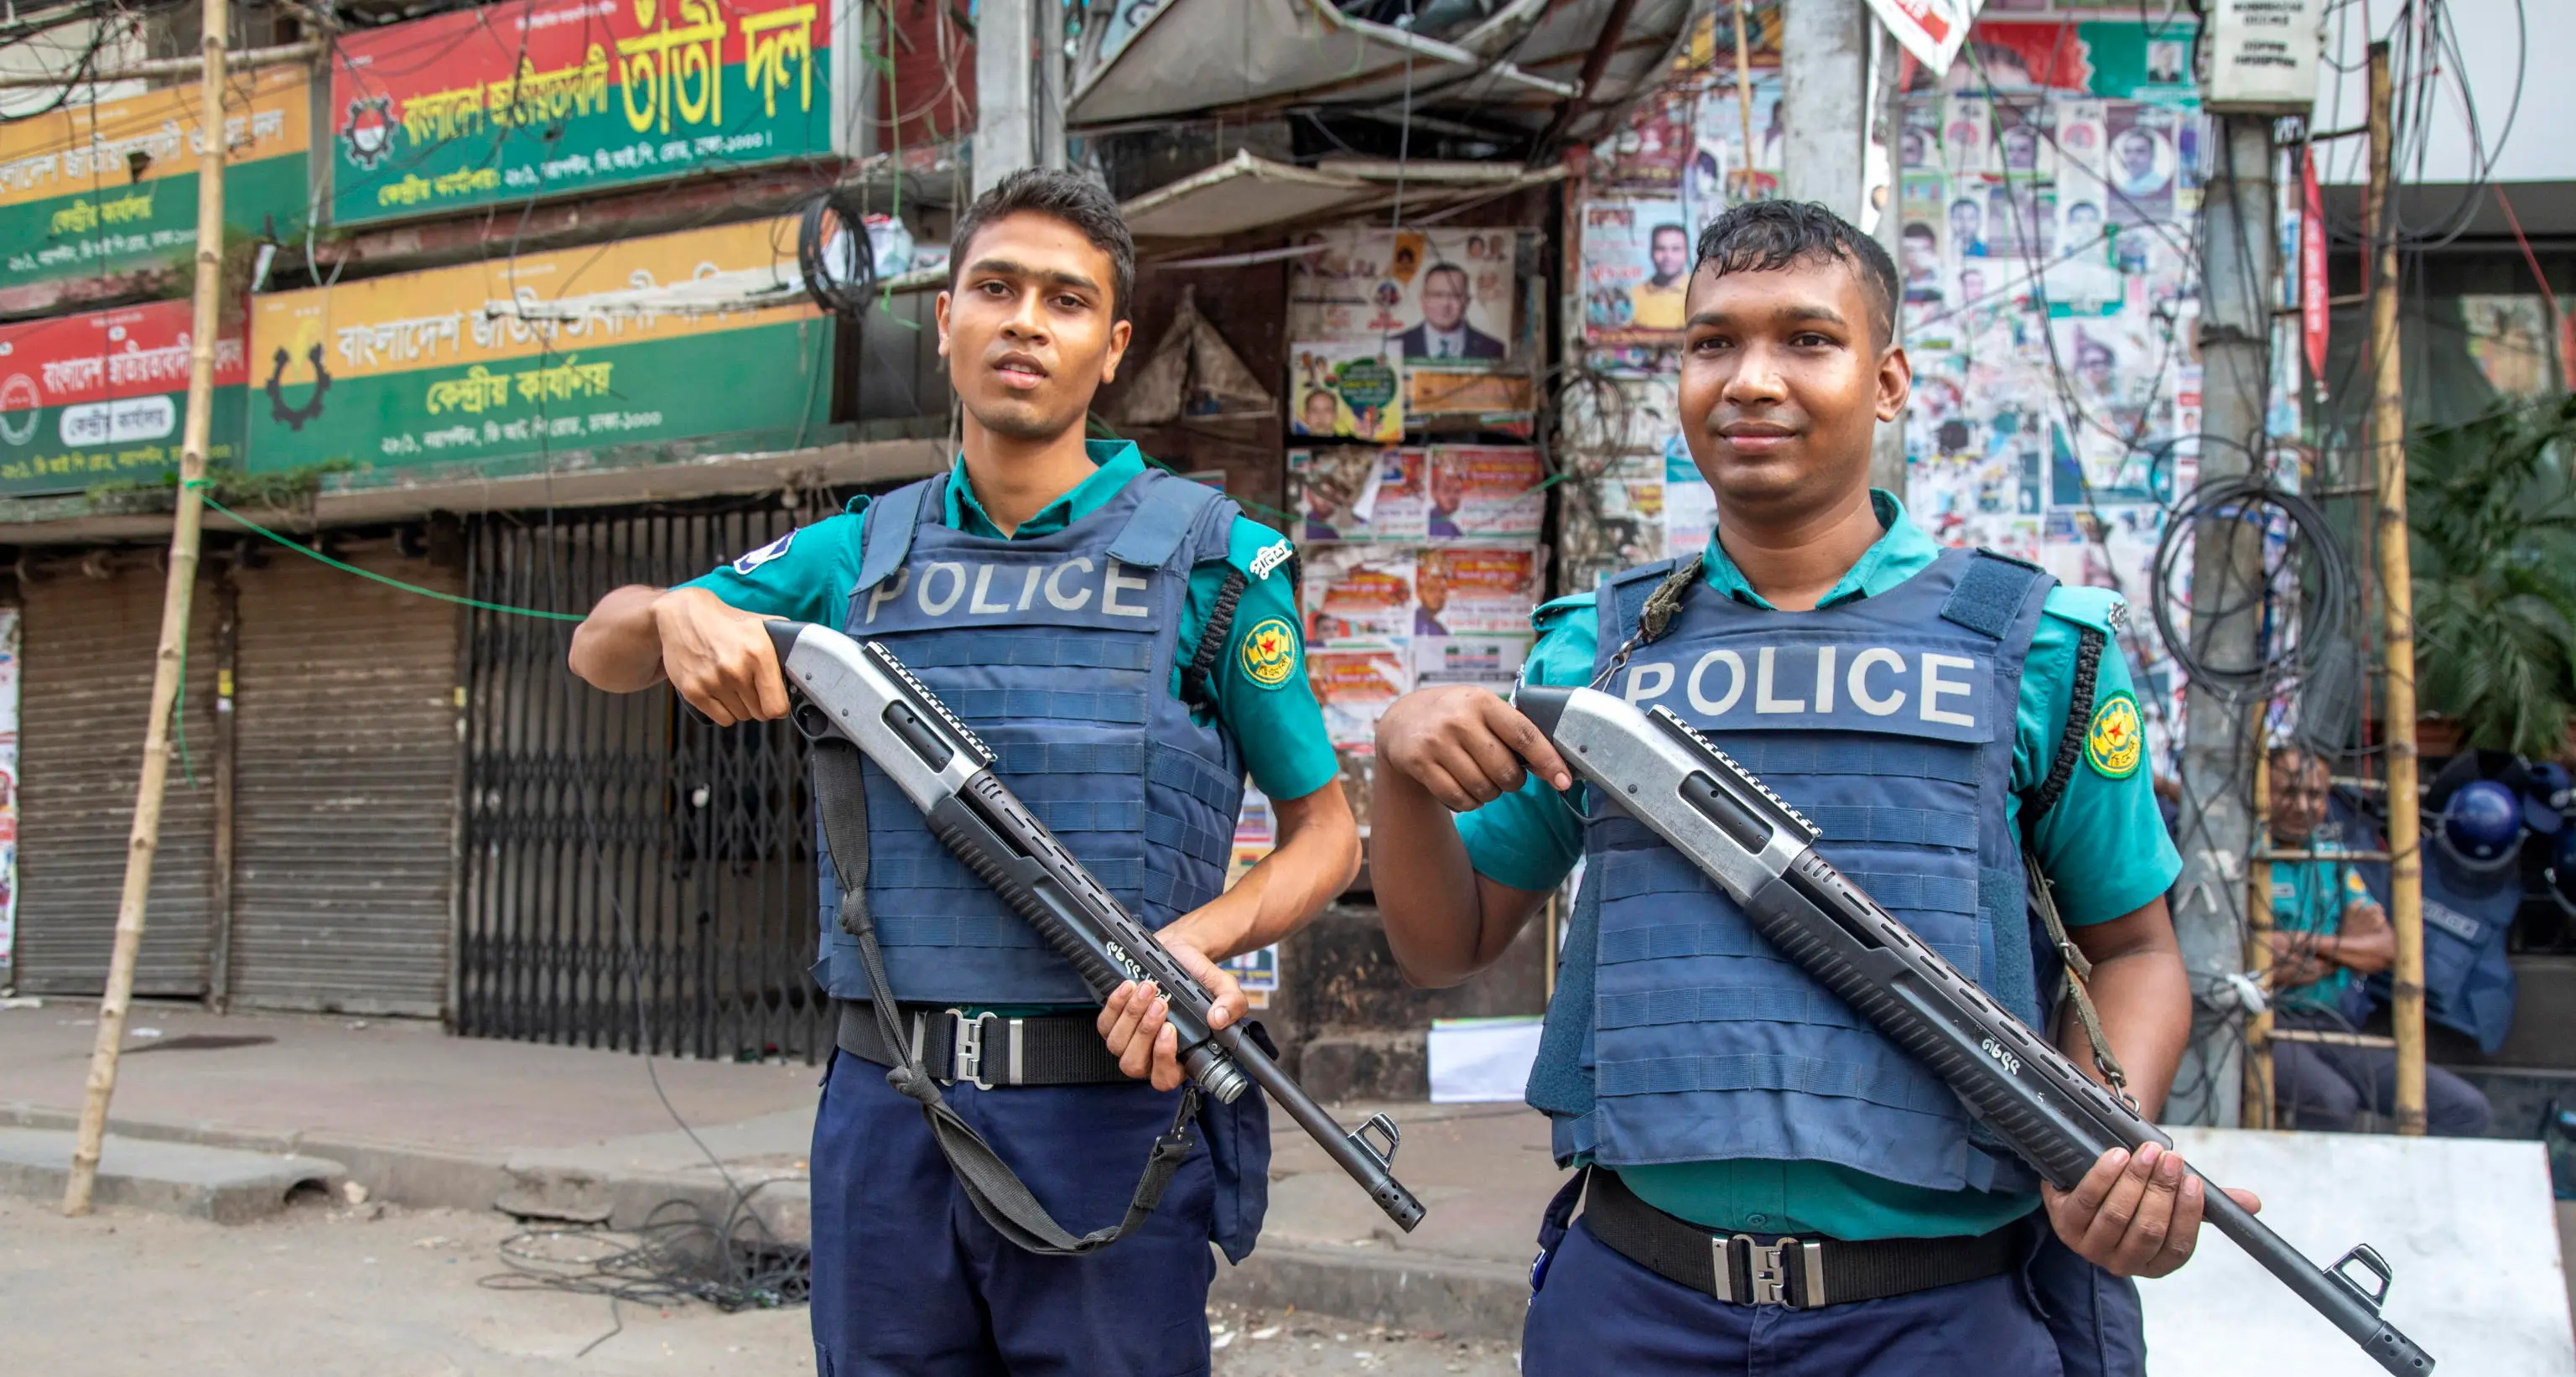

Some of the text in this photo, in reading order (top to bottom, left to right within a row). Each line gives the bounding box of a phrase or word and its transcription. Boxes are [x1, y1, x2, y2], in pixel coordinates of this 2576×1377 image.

[740, 3, 817, 118] দল
[336, 309, 465, 367] বাংলাদেশ
[426, 365, 512, 415] কেন্দ্রীয়
[865, 555, 1149, 625] POLICE
[1624, 645, 1976, 728] POLICE
